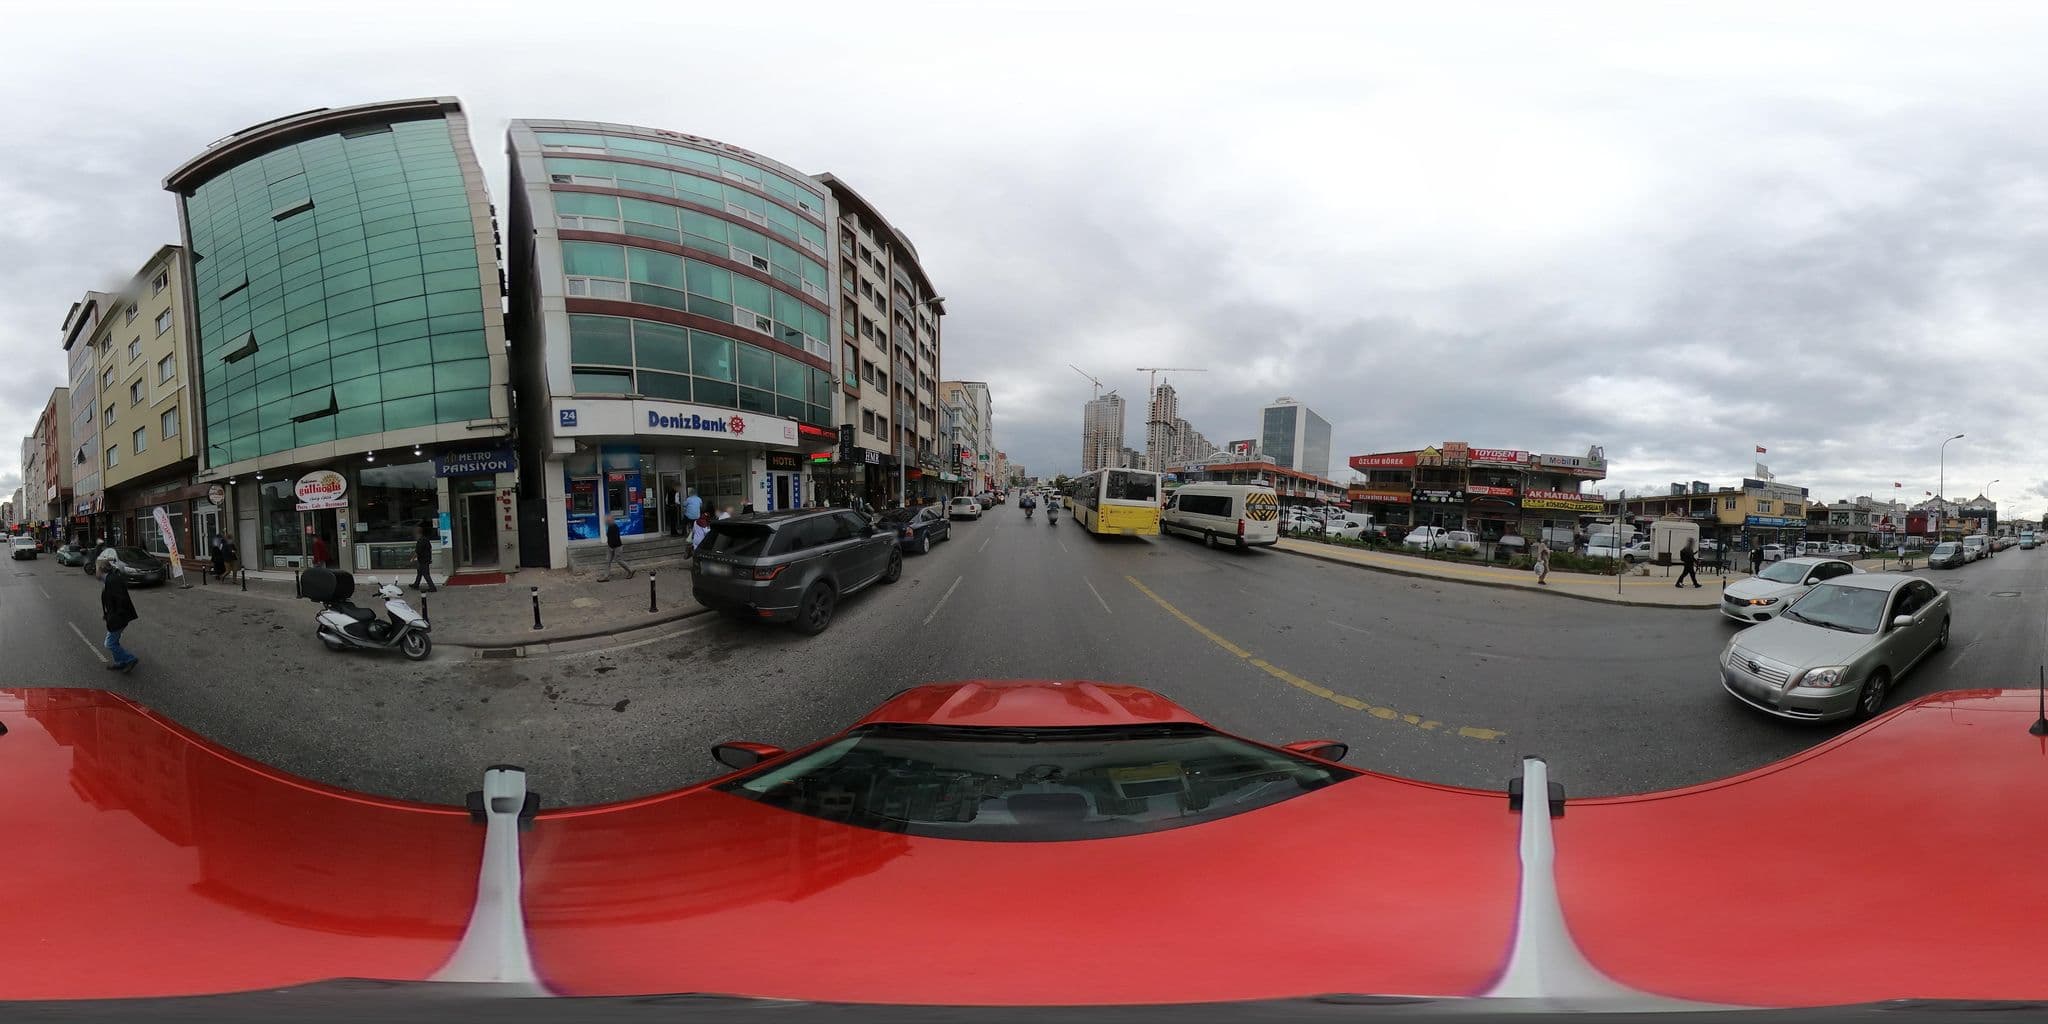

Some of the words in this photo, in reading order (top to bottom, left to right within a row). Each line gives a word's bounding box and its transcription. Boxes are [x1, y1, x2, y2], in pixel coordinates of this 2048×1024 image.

[562, 411, 576, 420] 24
[648, 410, 727, 433] DenizBank
[459, 452, 492, 462] METRO
[1474, 449, 1515, 458] TOYOSEN
[772, 456, 796, 466] HOTEL
[1549, 456, 1571, 465] Mobil
[442, 460, 507, 473] PANSİYON
[1529, 490, 1542, 498] AK
[1543, 491, 1581, 500] MATBAA
[502, 489, 513, 530] HOTEL
